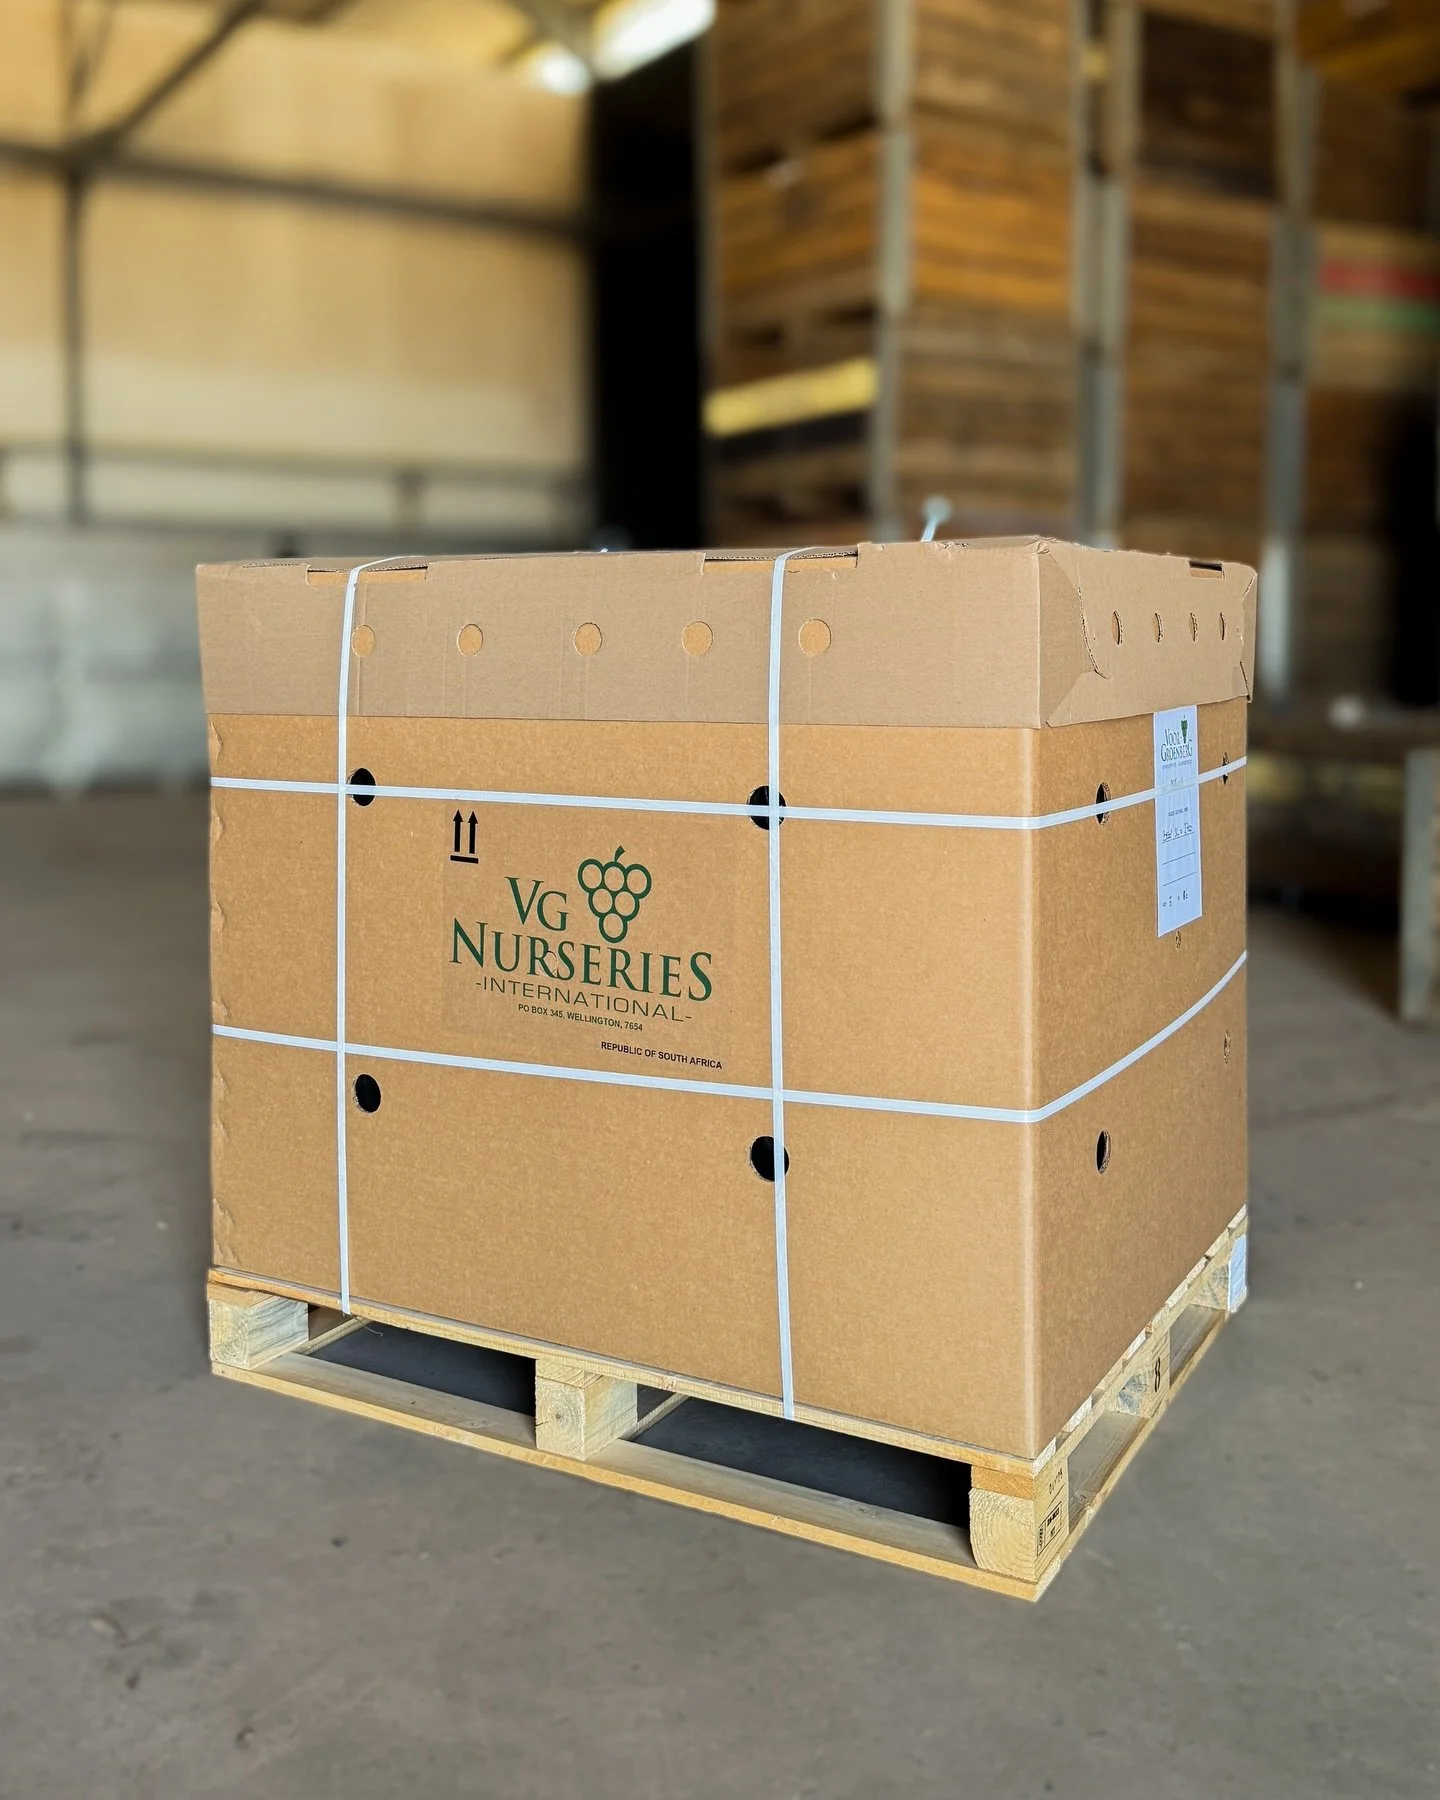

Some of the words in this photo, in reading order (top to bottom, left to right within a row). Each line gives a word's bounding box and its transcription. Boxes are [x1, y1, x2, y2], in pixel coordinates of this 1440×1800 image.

[504, 875, 570, 932] VG
[449, 917, 713, 1002] NURSERIES
[475, 976, 692, 1022] -INTERNATIONAL-
[518, 1003, 530, 1013] PO
[531, 1005, 548, 1017] BOX
[549, 1008, 566, 1020] 345,
[566, 1011, 623, 1030] WELLINGTON,
[623, 1021, 643, 1032] 7654
[600, 1041, 643, 1057] REPUBLIC
[644, 1047, 657, 1059] OF
[657, 1050, 688, 1064] SOUTH
[689, 1055, 723, 1070] AFRICA
